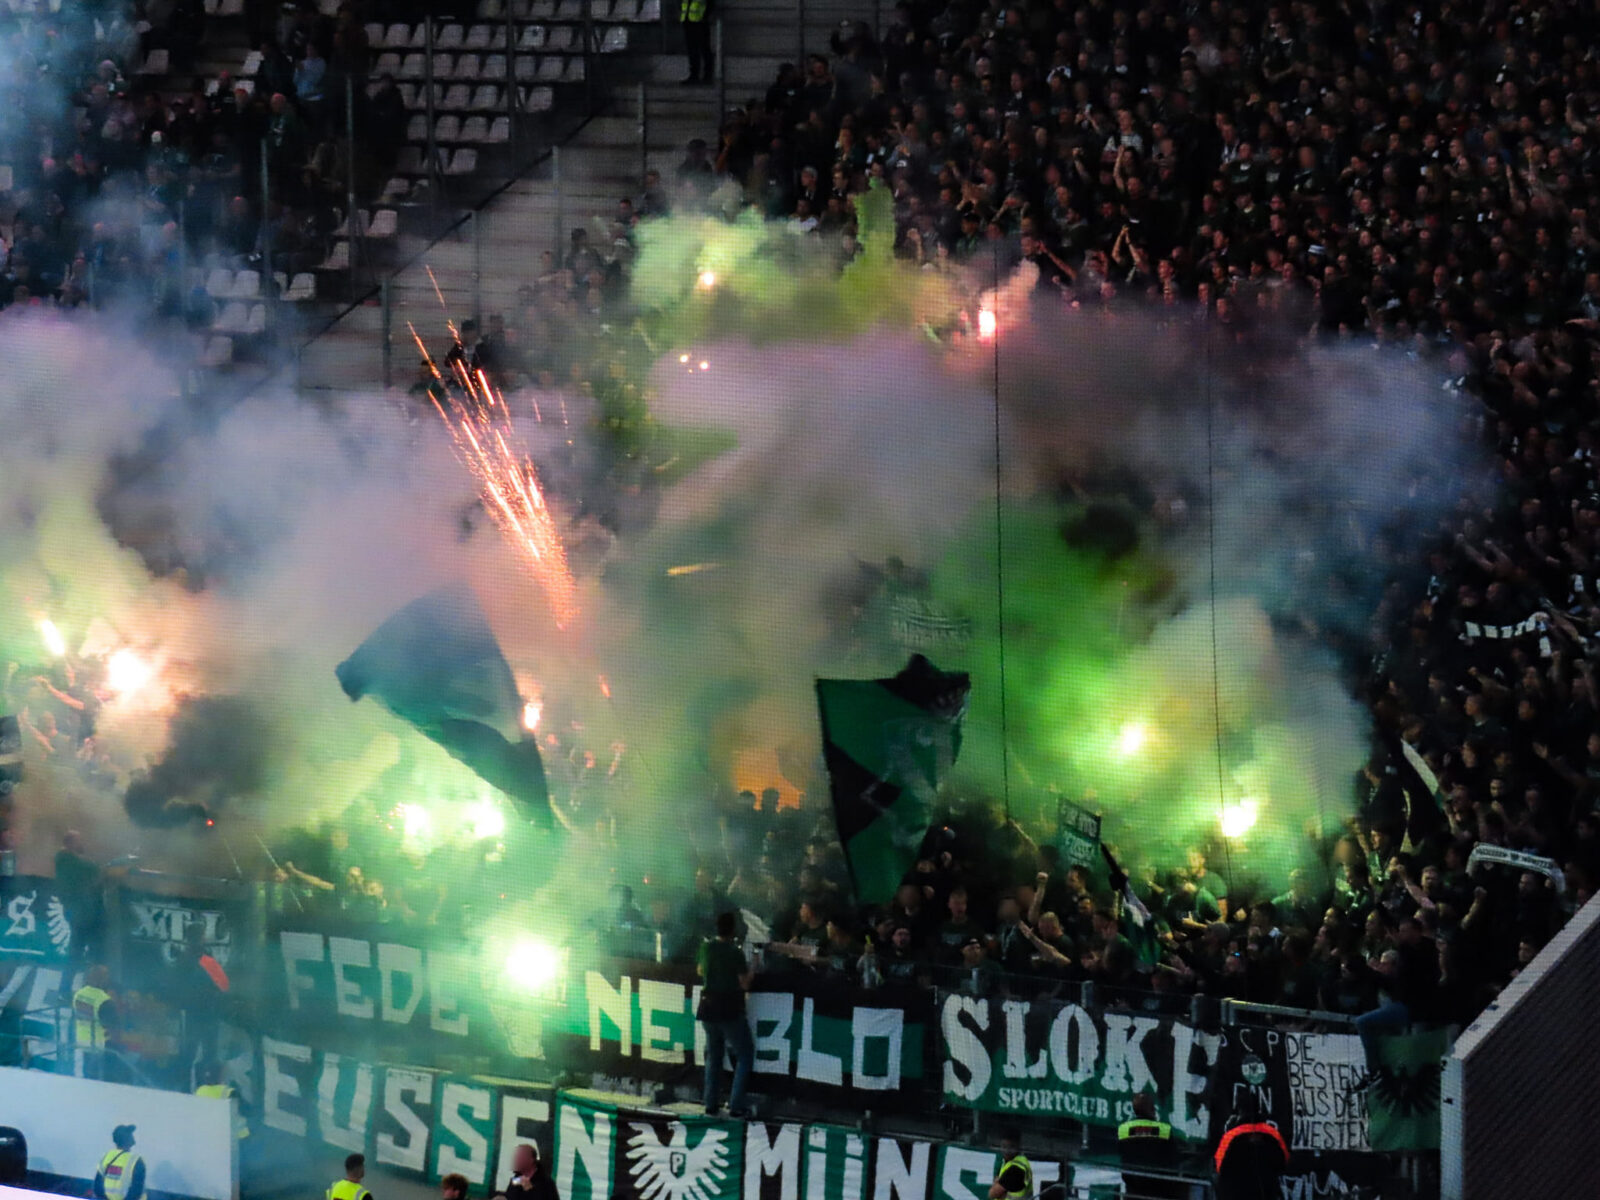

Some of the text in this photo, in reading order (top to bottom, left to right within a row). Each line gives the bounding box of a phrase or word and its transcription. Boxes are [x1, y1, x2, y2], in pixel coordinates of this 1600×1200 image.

[942, 994, 1221, 1140] SLOKE
[1288, 1062, 1368, 1092] BESTEN
[998, 1087, 1110, 1118] SPORTCLUB
[1293, 1089, 1330, 1117] AUS
[1294, 1121, 1371, 1149] WESTEN
